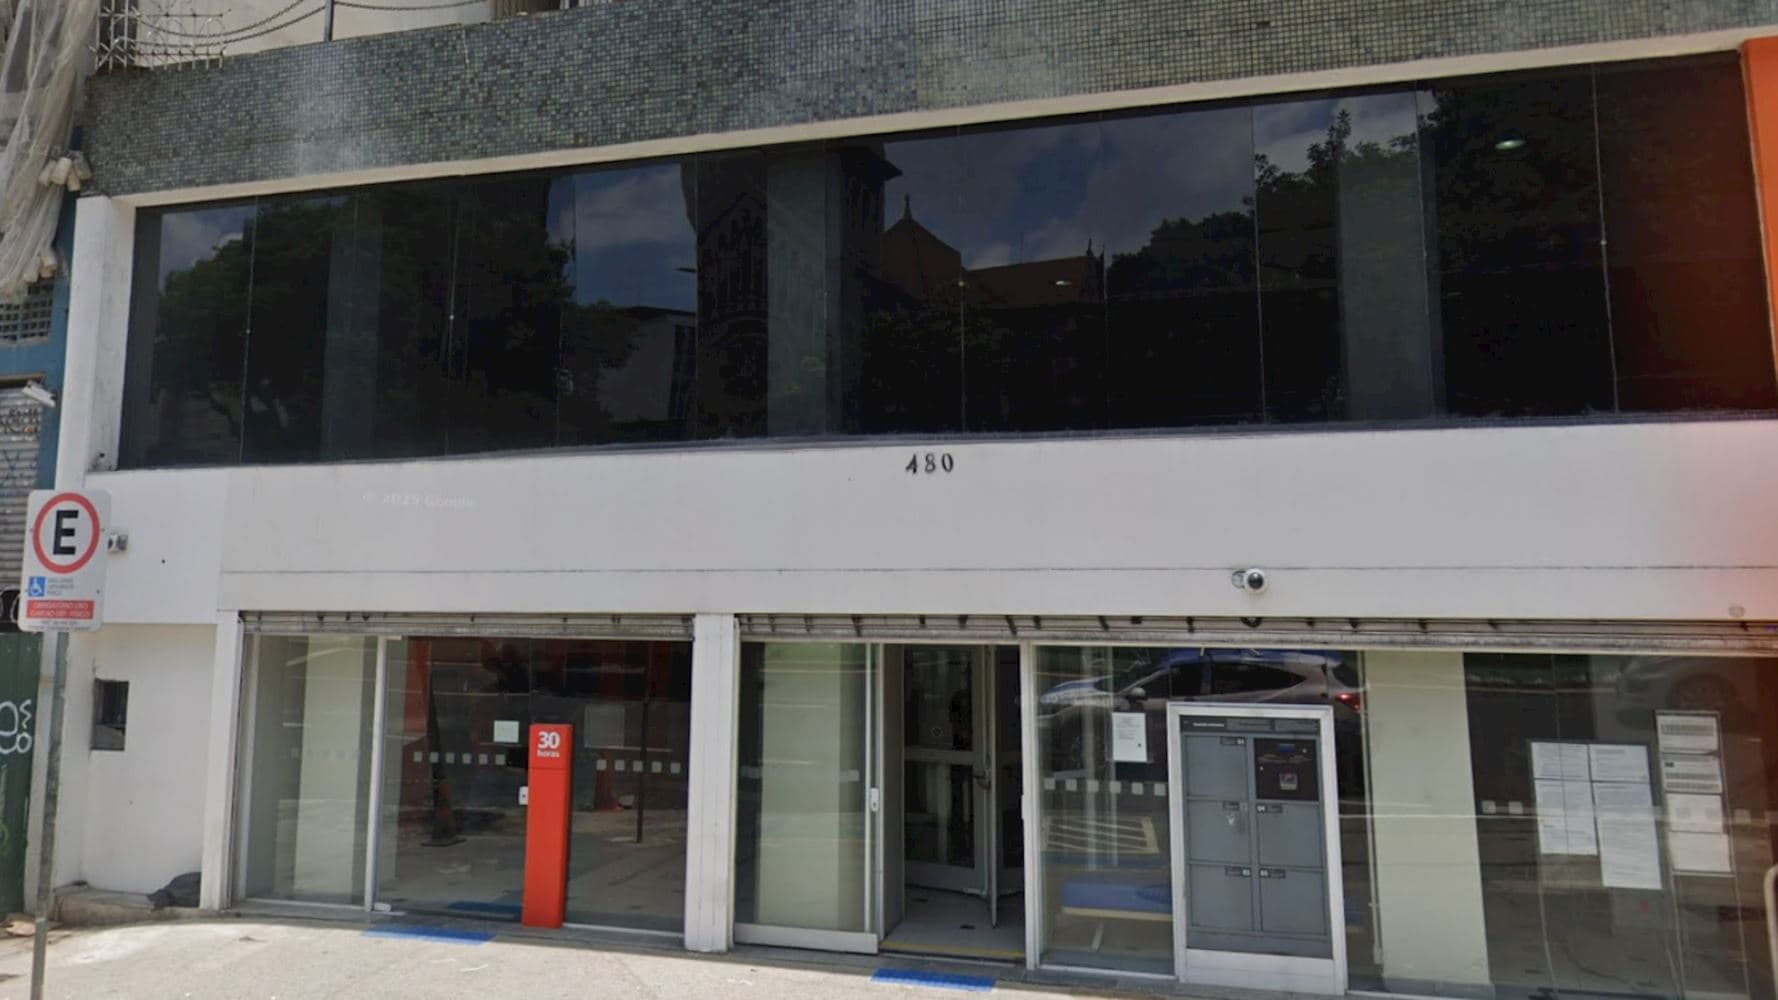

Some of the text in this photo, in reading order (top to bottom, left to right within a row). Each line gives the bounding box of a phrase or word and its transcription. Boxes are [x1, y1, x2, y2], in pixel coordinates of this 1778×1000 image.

[905, 453, 954, 474] 480
[53, 510, 79, 555] E
[537, 731, 560, 749] 30
[537, 749, 560, 758] horas
